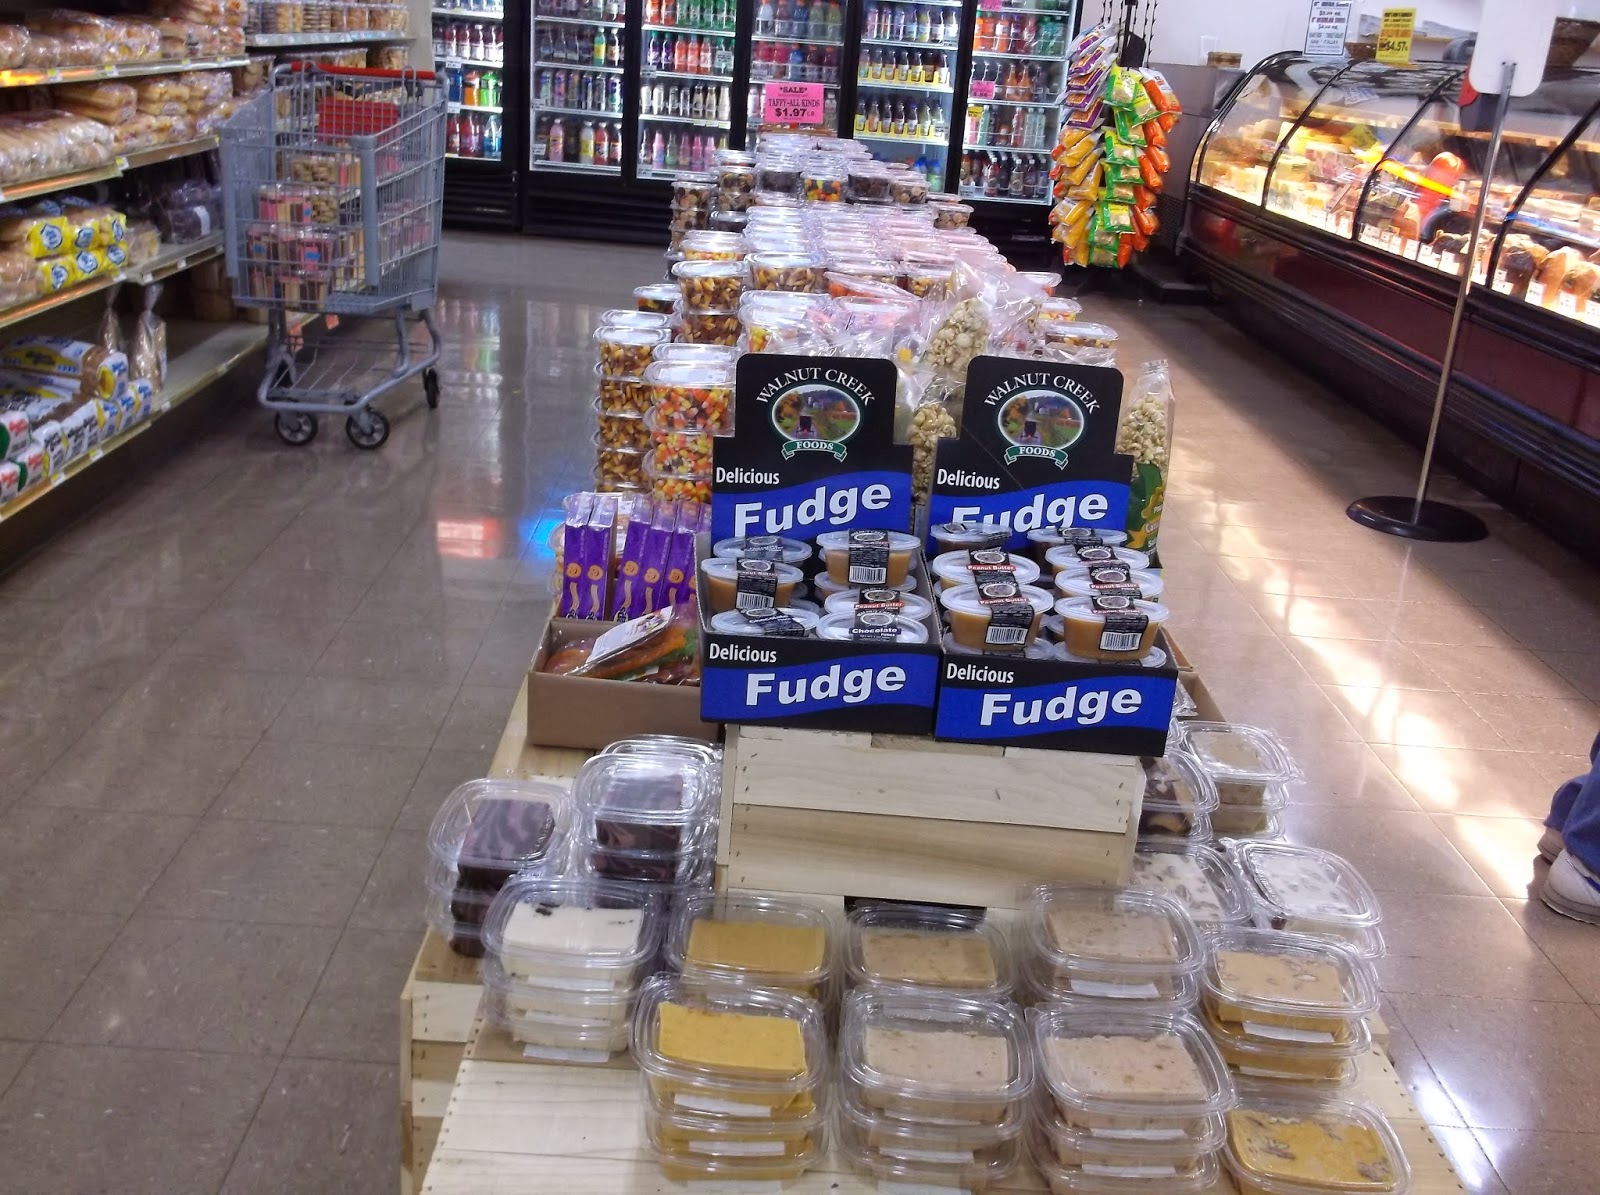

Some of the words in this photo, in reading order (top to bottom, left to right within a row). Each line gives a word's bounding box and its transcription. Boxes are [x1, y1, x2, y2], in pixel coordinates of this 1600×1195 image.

[775, 108, 807, 117] $1.97
[755, 367, 822, 405] WALNUT
[825, 368, 876, 407] CREEK
[984, 372, 1051, 407] WALNUT
[1053, 375, 1101, 415] CREEK
[796, 441, 834, 451] FOODS
[1018, 446, 1056, 458] FOODS
[715, 467, 780, 485] Delicious
[936, 468, 1000, 490] Delicious
[735, 483, 892, 537] Fudge
[709, 642, 777, 663] Delicious
[946, 662, 1014, 684] Delicious
[746, 664, 907, 706] Fudge
[980, 685, 1142, 726] Fudge
